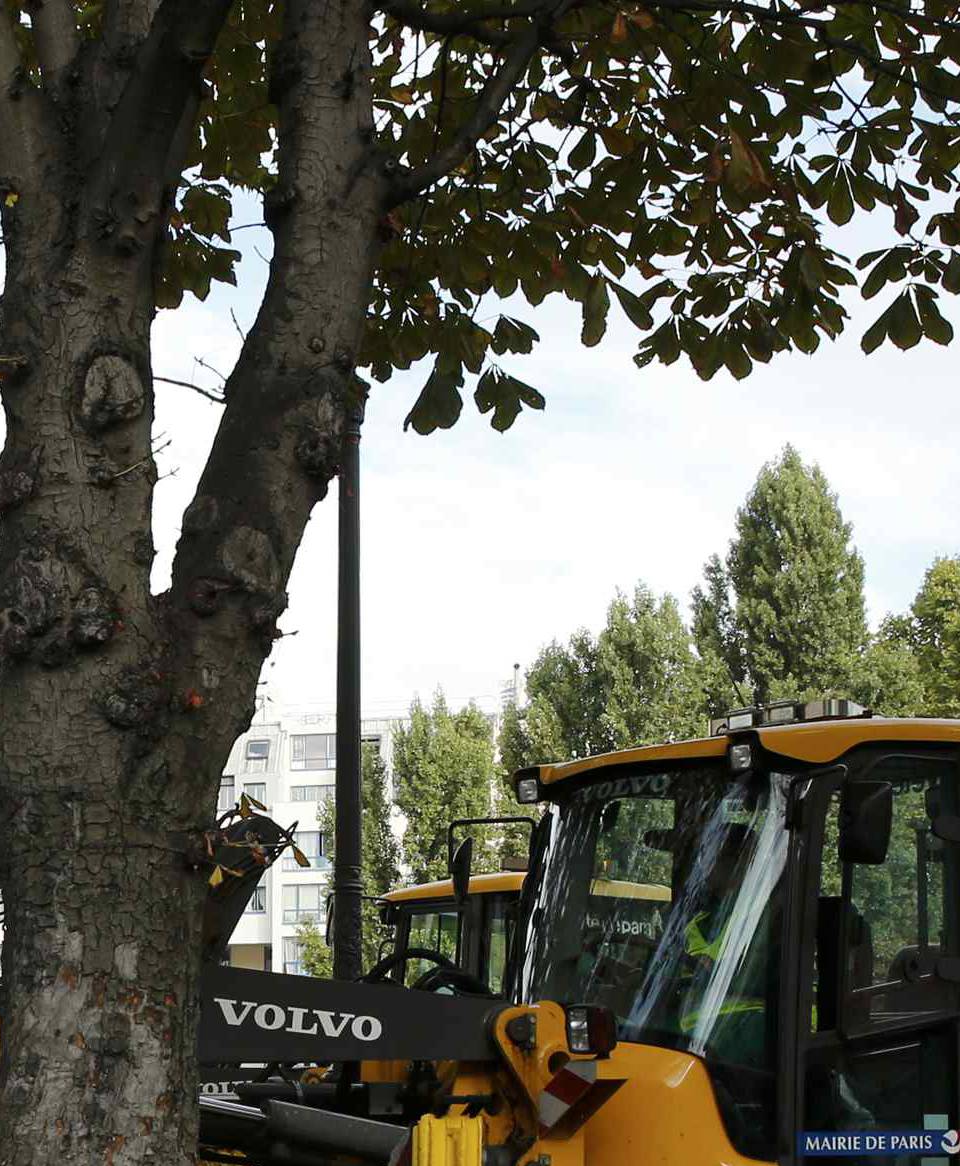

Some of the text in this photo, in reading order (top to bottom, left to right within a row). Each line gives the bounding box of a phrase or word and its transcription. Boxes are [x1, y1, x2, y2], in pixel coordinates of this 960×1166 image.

[213, 997, 383, 1042] VOLVO
[805, 1135, 933, 1151] MAIRIE DE PARIS
